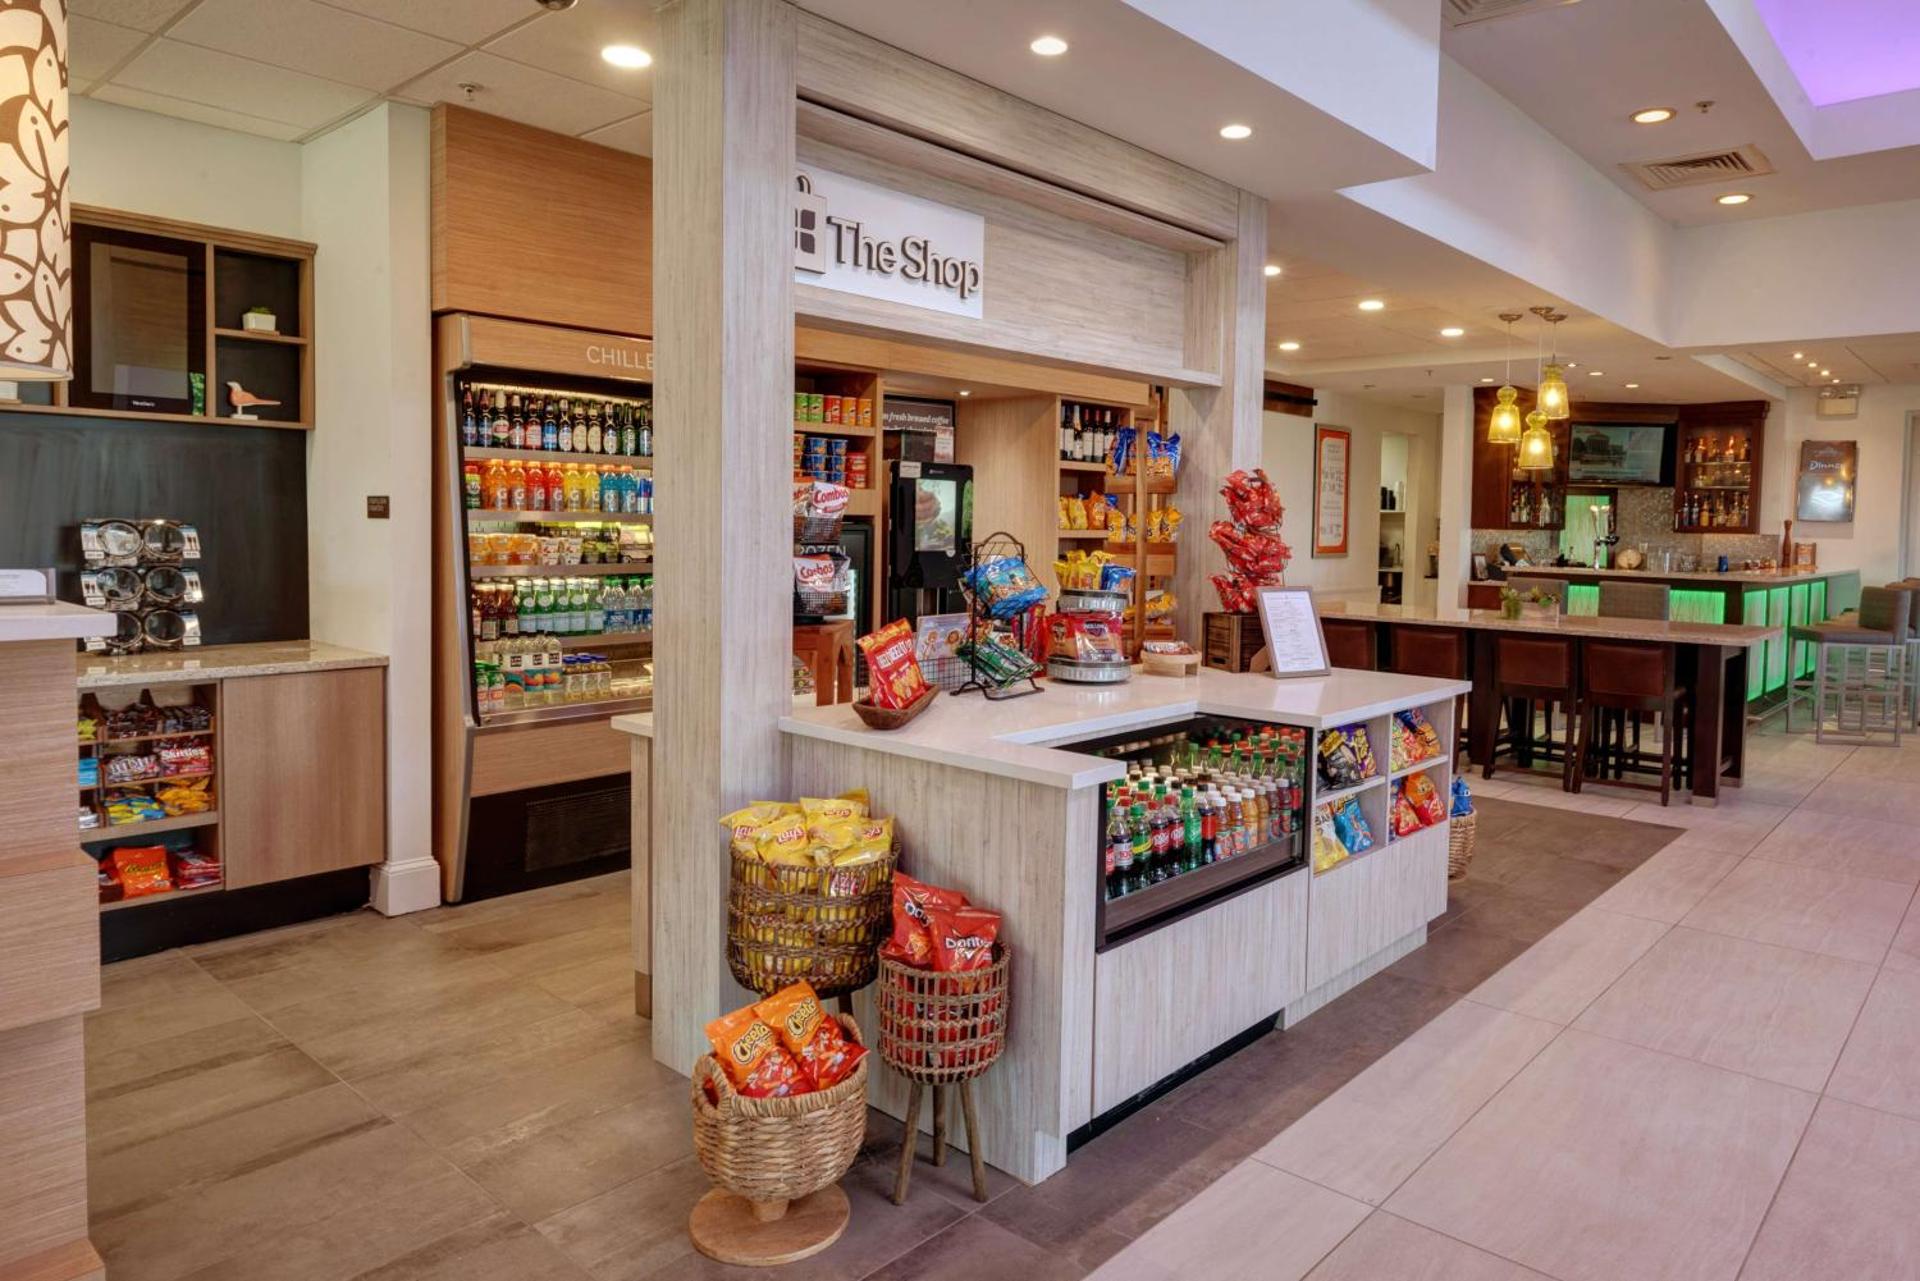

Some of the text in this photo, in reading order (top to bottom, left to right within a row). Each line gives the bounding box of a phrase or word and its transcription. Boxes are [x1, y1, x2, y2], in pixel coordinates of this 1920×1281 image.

[826, 215, 980, 299] The Shop
[888, 411, 907, 423] fresh
[907, 412, 930, 424] brewed
[931, 415, 949, 426] coffee
[813, 487, 849, 504] Combos
[161, 747, 207, 760] Skittles
